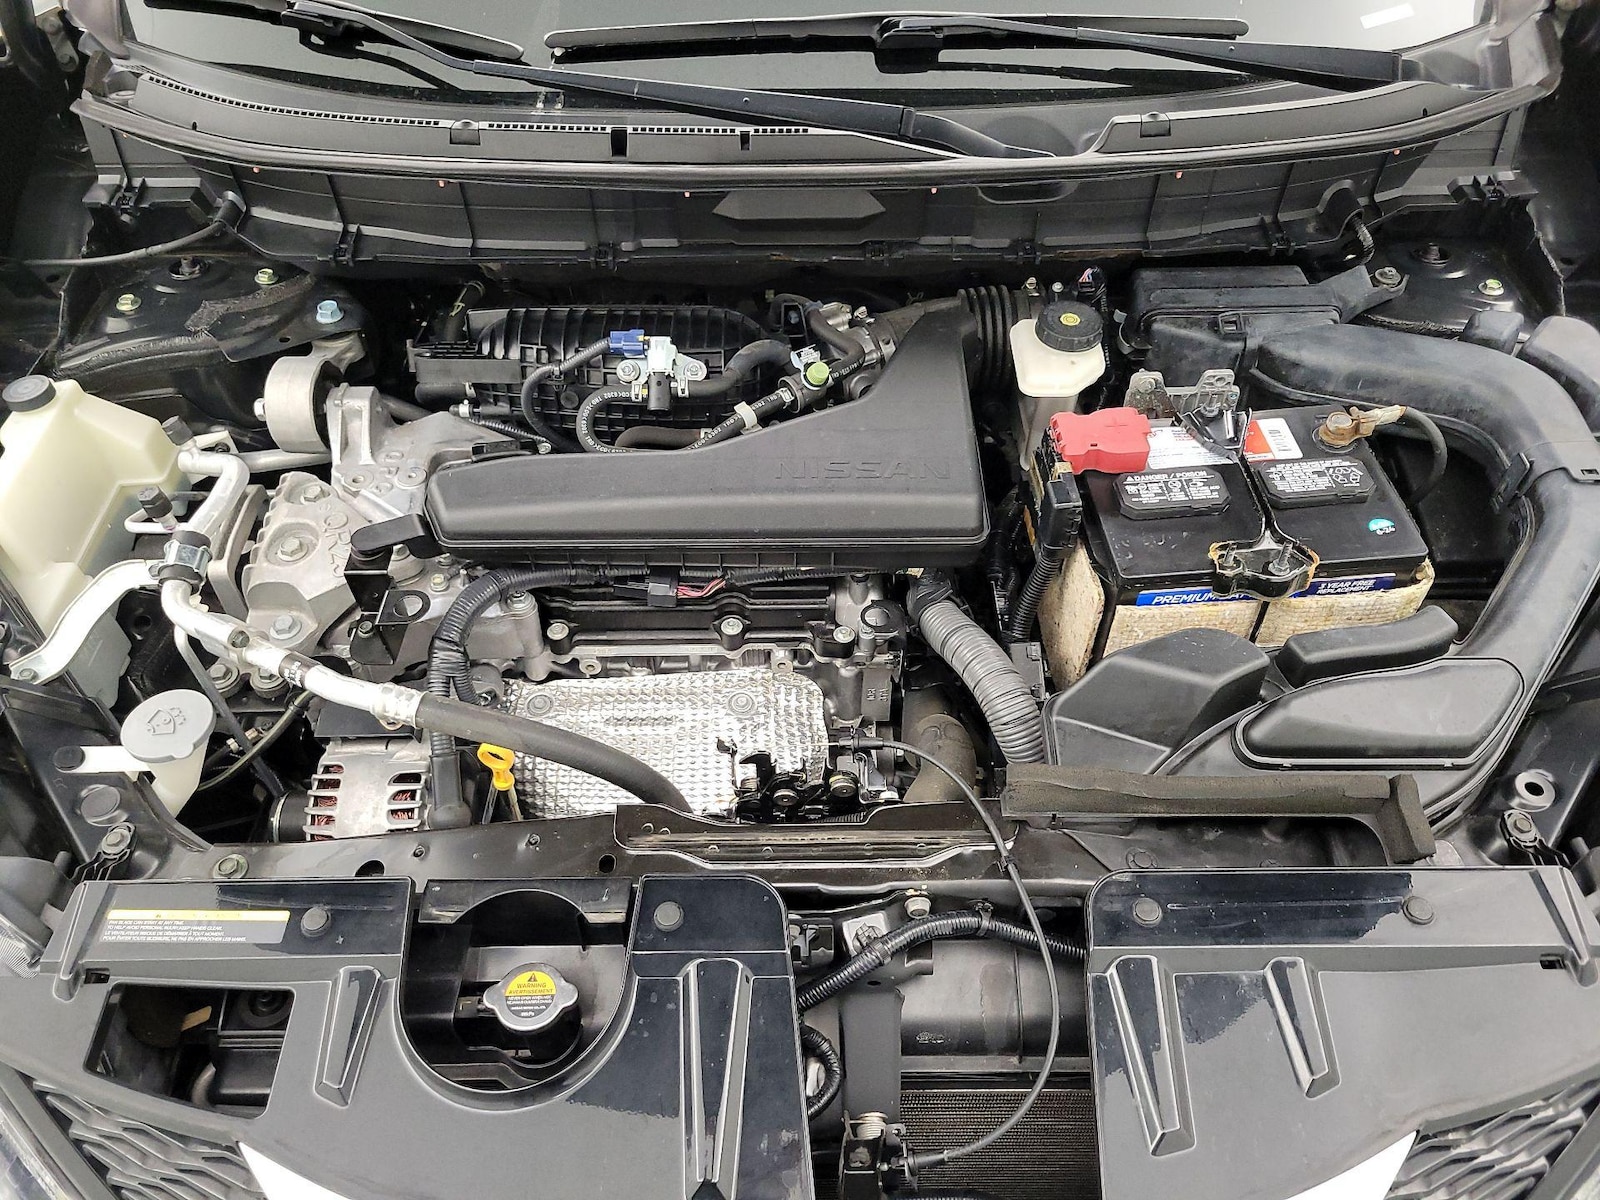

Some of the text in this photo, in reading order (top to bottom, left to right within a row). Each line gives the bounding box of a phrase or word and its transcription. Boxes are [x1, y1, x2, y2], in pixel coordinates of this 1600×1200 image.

[775, 461, 951, 480] NISSAN
[1134, 473, 1169, 482] DANGER
[1327, 581, 1351, 589] YEAR
[1351, 579, 1377, 587] FREE
[1316, 586, 1371, 595] REPLACEMENT
[1152, 592, 1216, 605] PREMIUM
